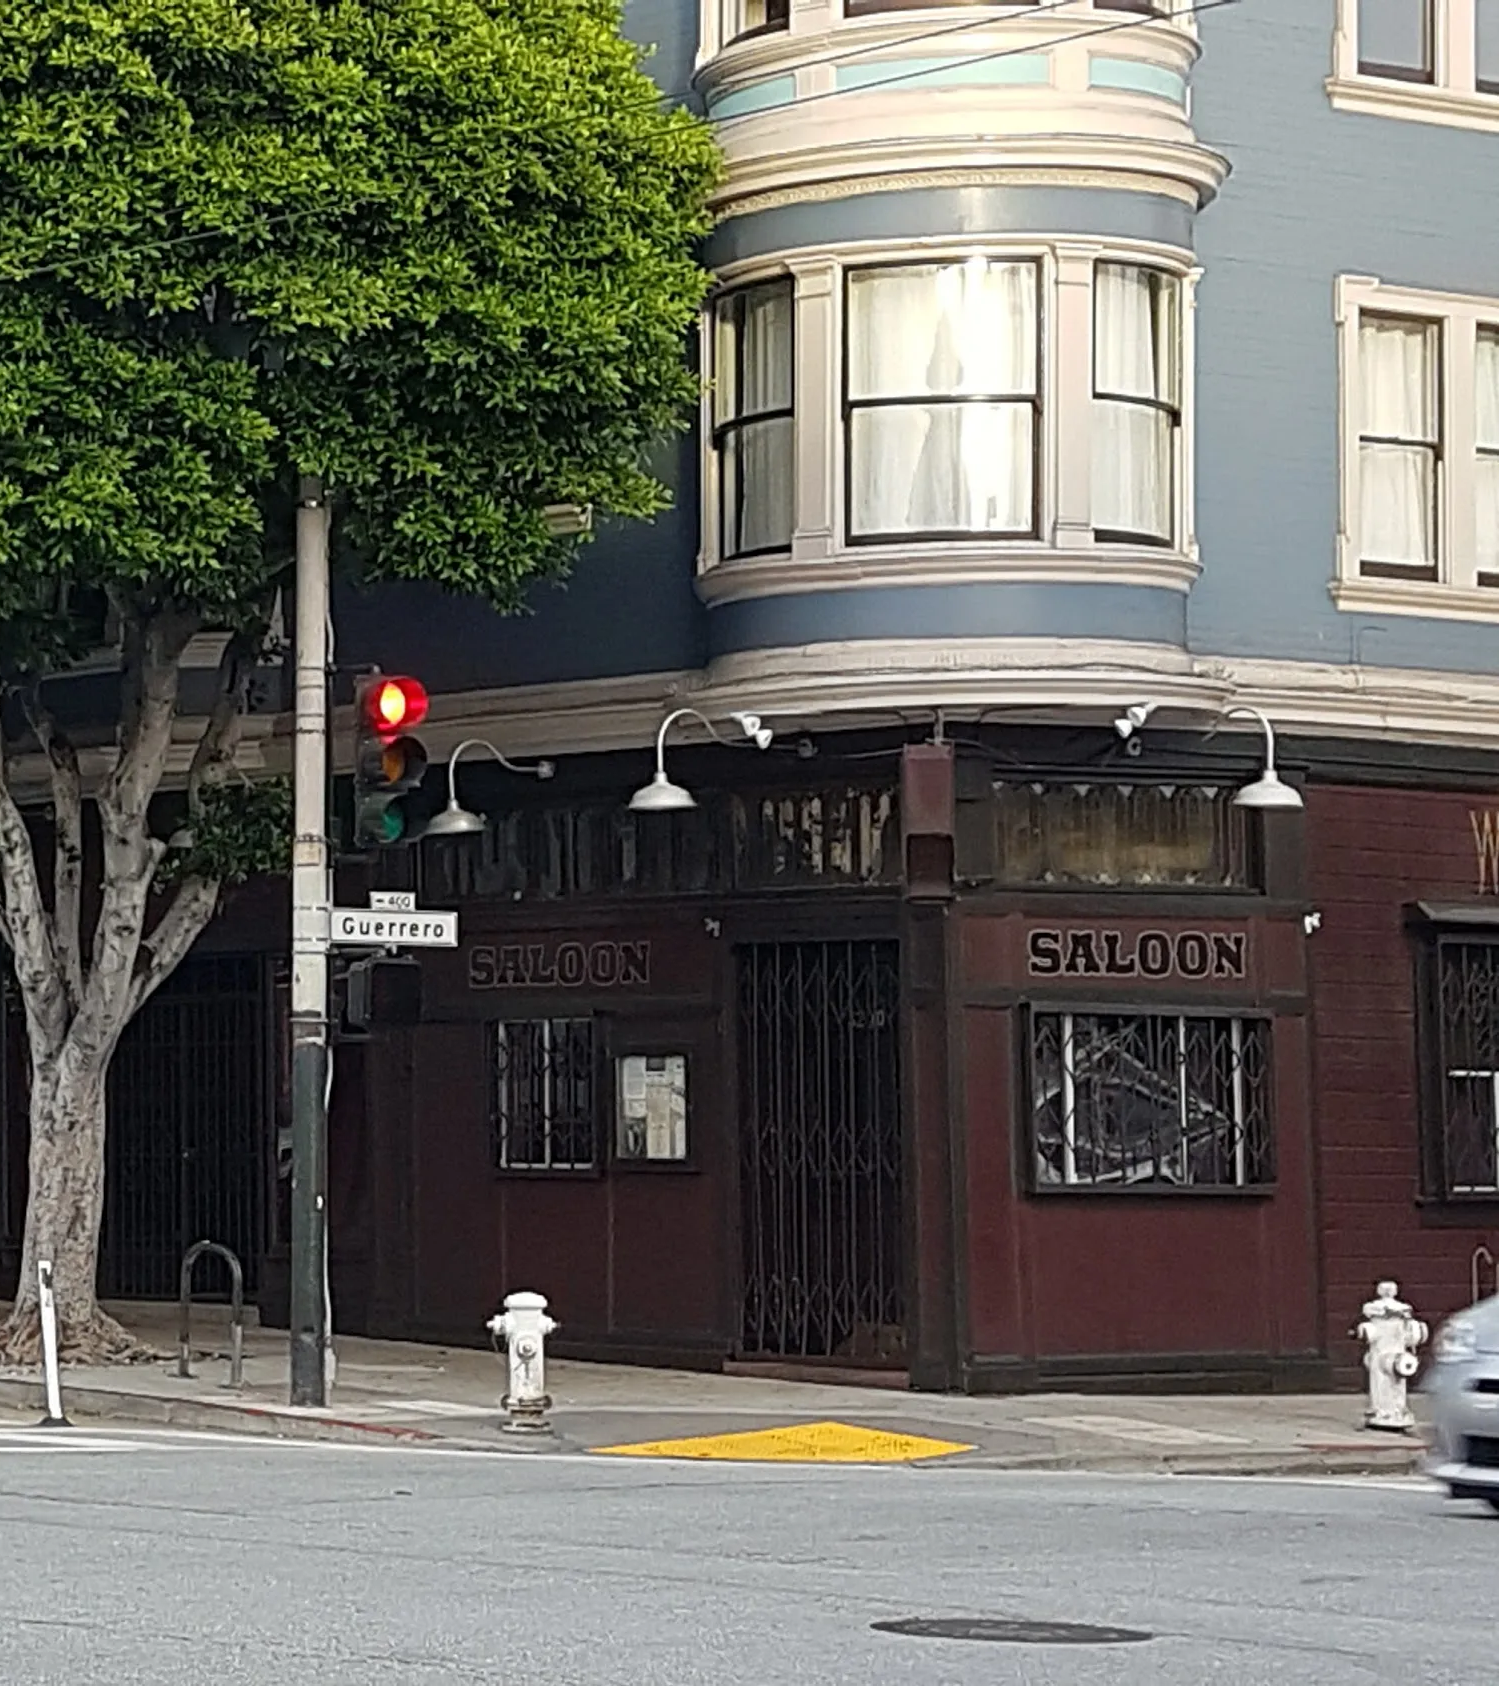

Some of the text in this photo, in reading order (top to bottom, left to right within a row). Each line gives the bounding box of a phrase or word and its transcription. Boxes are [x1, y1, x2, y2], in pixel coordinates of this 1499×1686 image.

[388, 896, 411, 908] 400
[342, 916, 444, 938] Guerrero
[469, 942, 651, 988] SALOON
[1028, 929, 1246, 979] SALOON
